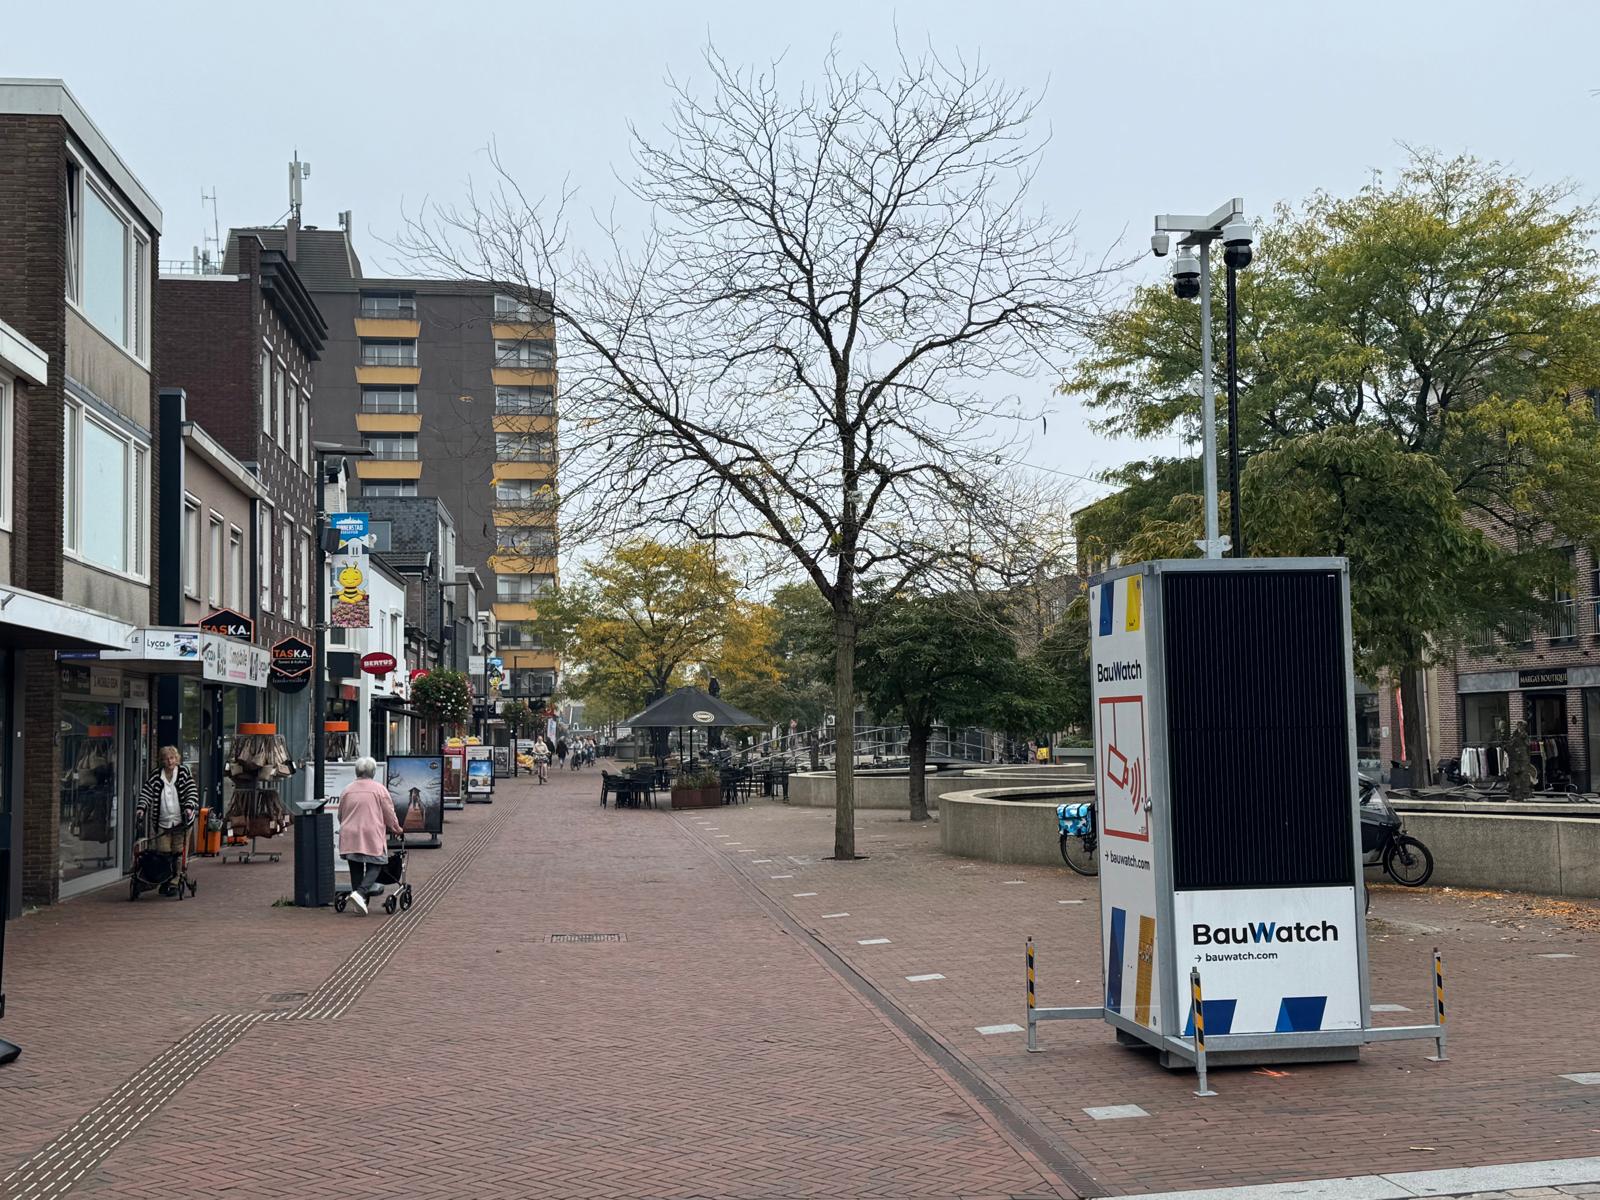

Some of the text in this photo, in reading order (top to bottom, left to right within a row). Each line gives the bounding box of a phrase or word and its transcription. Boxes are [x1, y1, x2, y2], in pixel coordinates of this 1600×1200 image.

[273, 649, 312, 658] TASKA.
[363, 659, 394, 667] BERTUS
[1097, 659, 1143, 683] BauWatch
[1109, 850, 1151, 871] bauwatch.com
[1192, 920, 1339, 945] BauWatch
[1205, 951, 1278, 962] bauwatch.com
